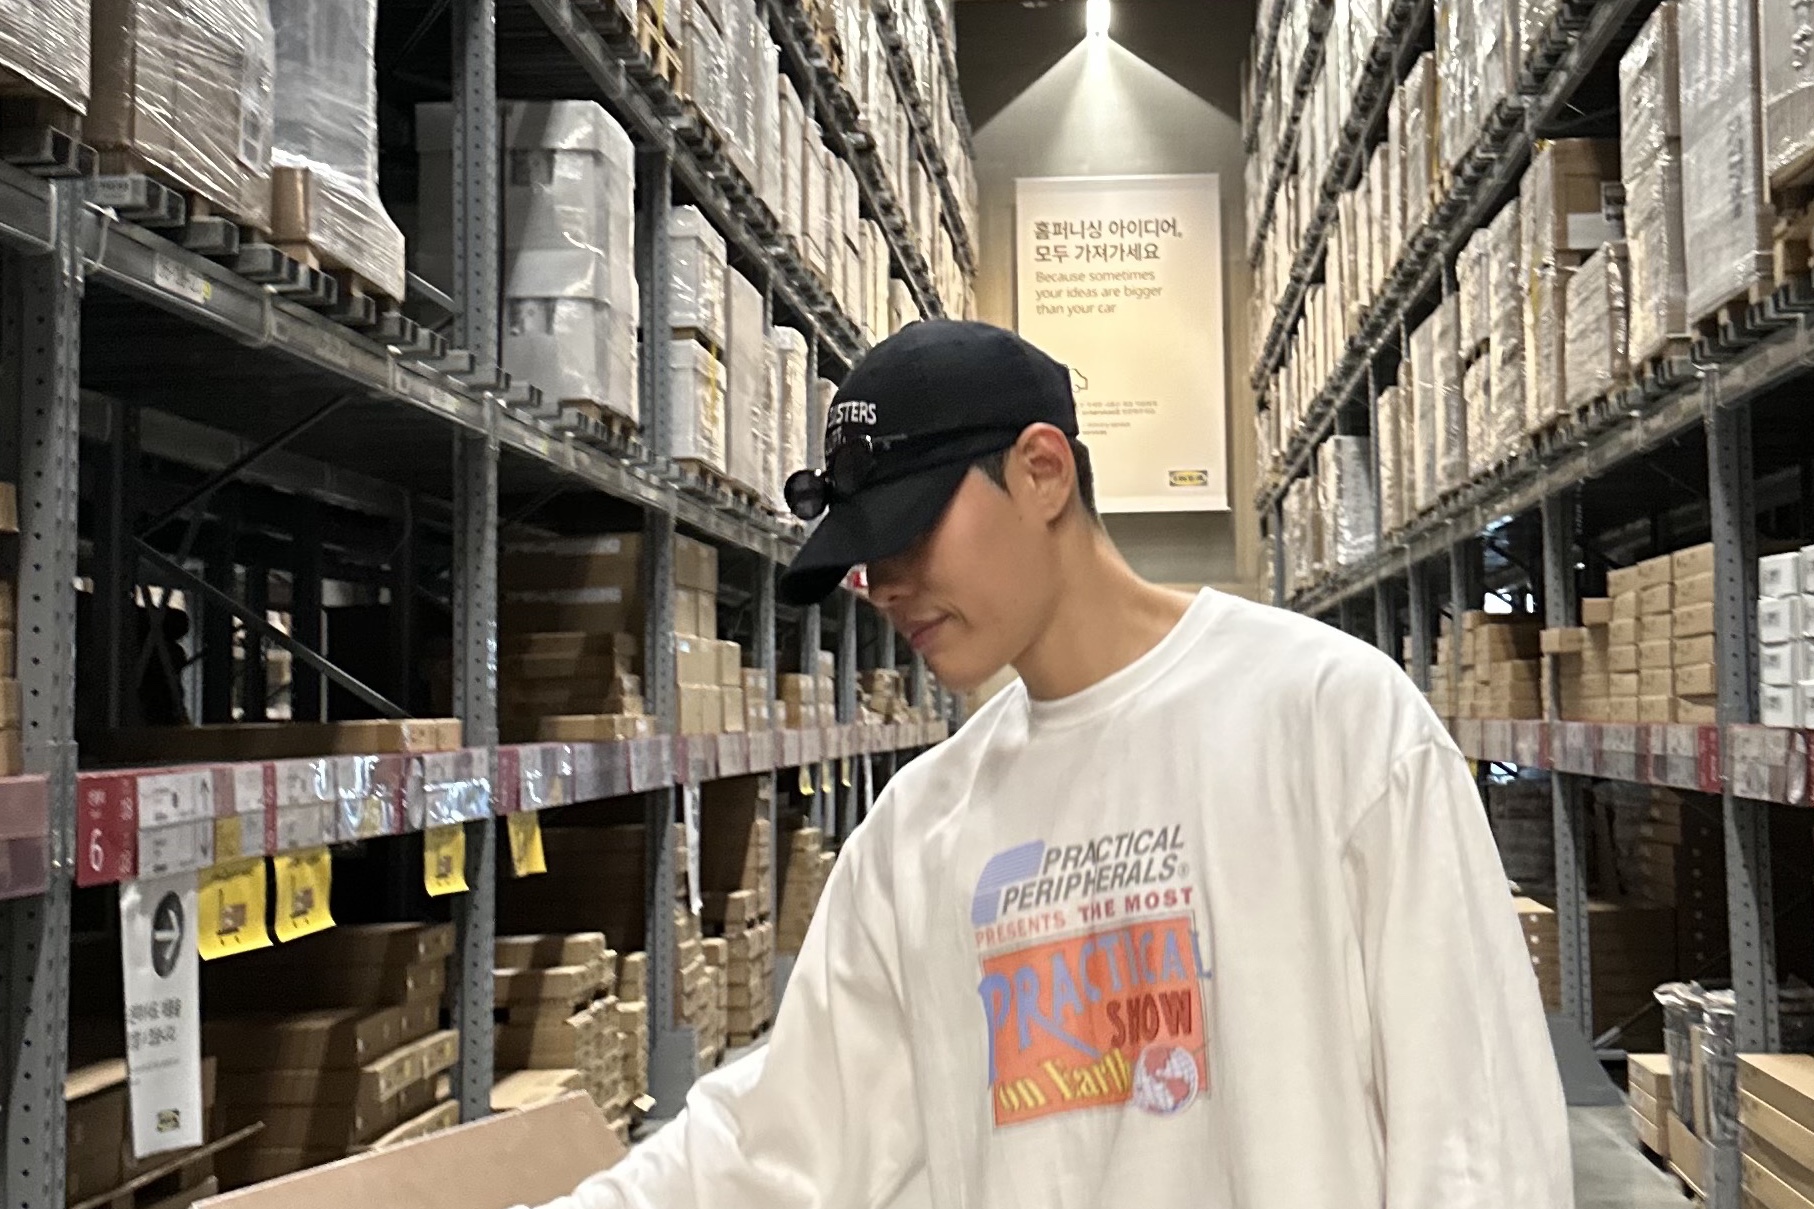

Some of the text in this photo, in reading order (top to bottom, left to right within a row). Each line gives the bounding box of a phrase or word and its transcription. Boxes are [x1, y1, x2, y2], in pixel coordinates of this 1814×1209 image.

[1034, 242, 1160, 263] 모두 가져가세요
[1035, 269, 1155, 283] Because sometimes
[1035, 285, 1163, 301] your ideas are bigger
[1036, 303, 1117, 317] than your car
[89, 823, 104, 872] 6
[1042, 824, 1186, 876] PRACTICAL
[974, 887, 1194, 947] PRESENTS THE MOST
[978, 929, 1212, 1090] PRACTICAL
[1106, 989, 1193, 1048] SHOW
